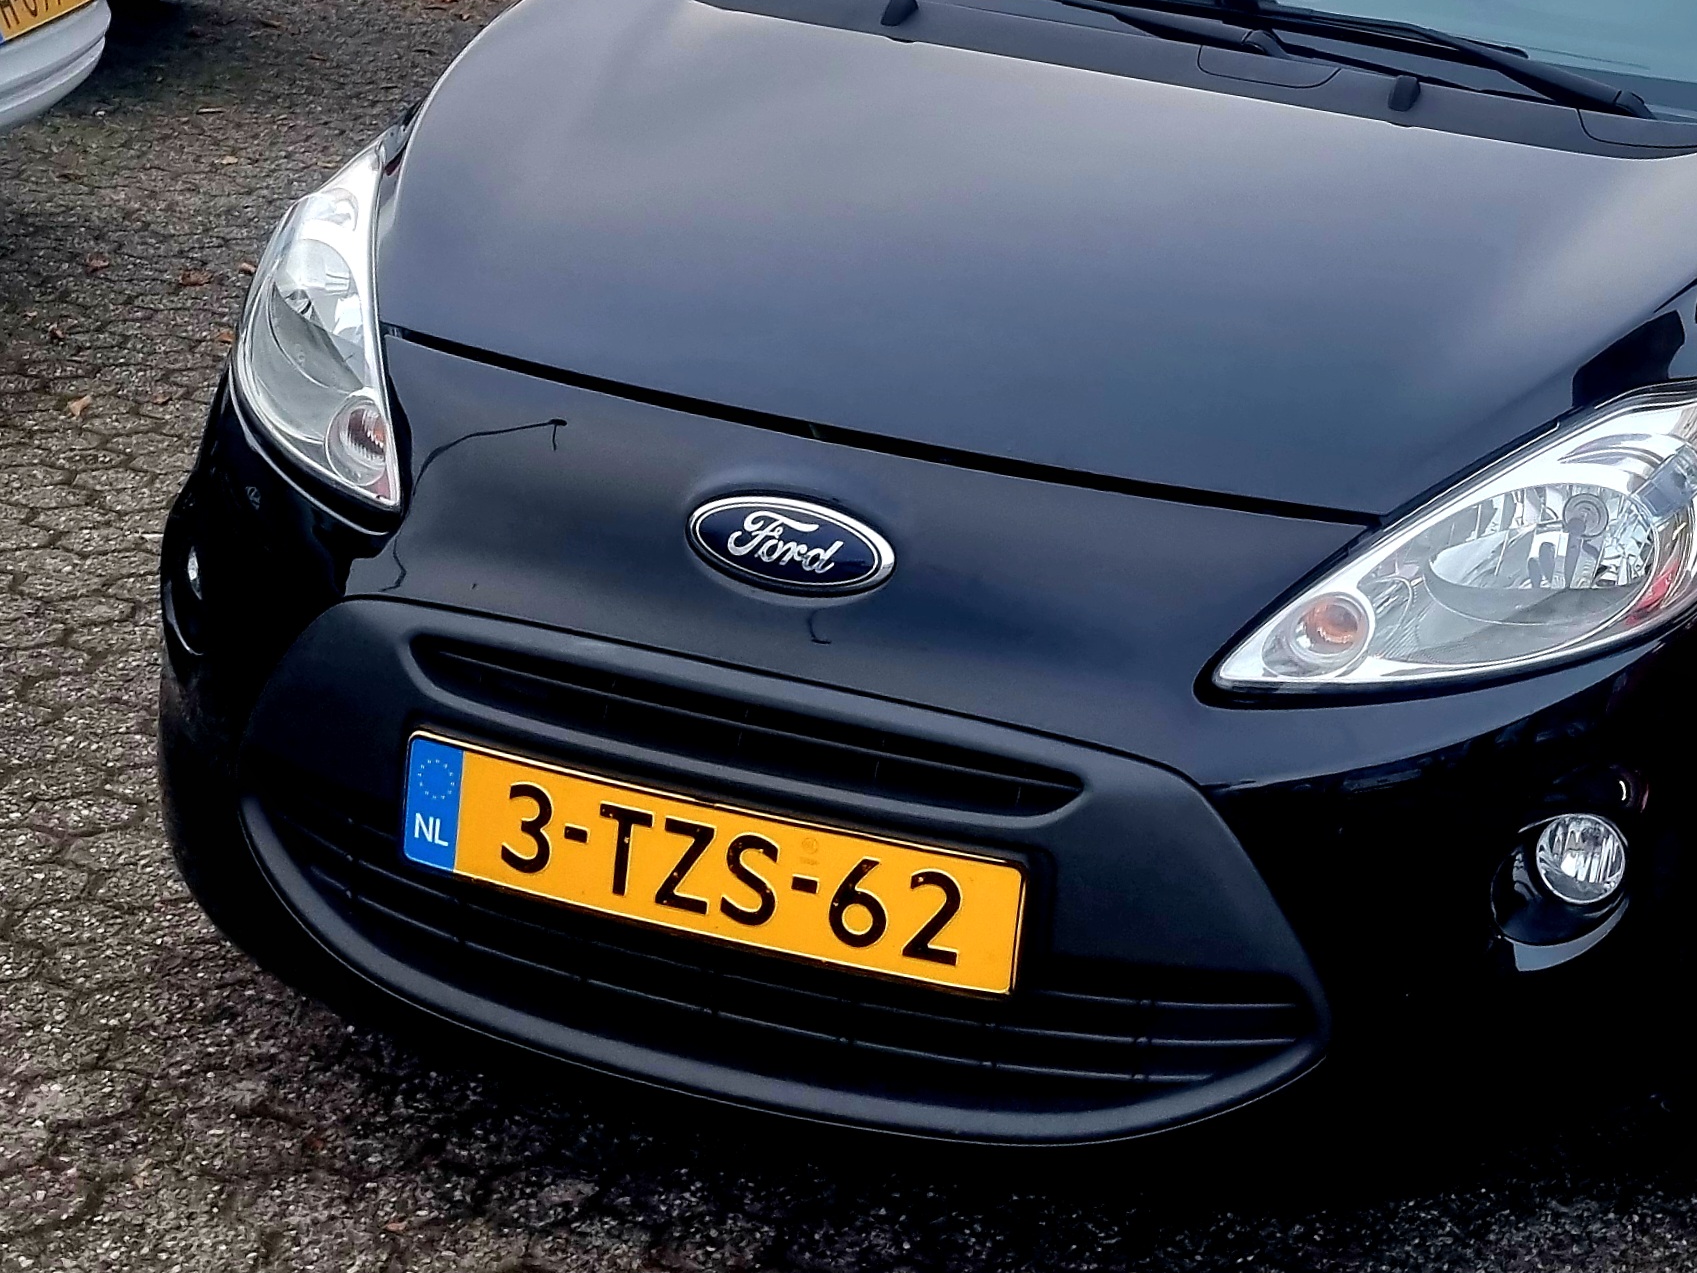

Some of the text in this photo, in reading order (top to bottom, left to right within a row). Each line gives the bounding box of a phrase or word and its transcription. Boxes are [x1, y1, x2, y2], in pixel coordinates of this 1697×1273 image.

[727, 510, 844, 574] Ford
[413, 812, 449, 848] NL
[500, 781, 963, 967] 3-TZS-62
